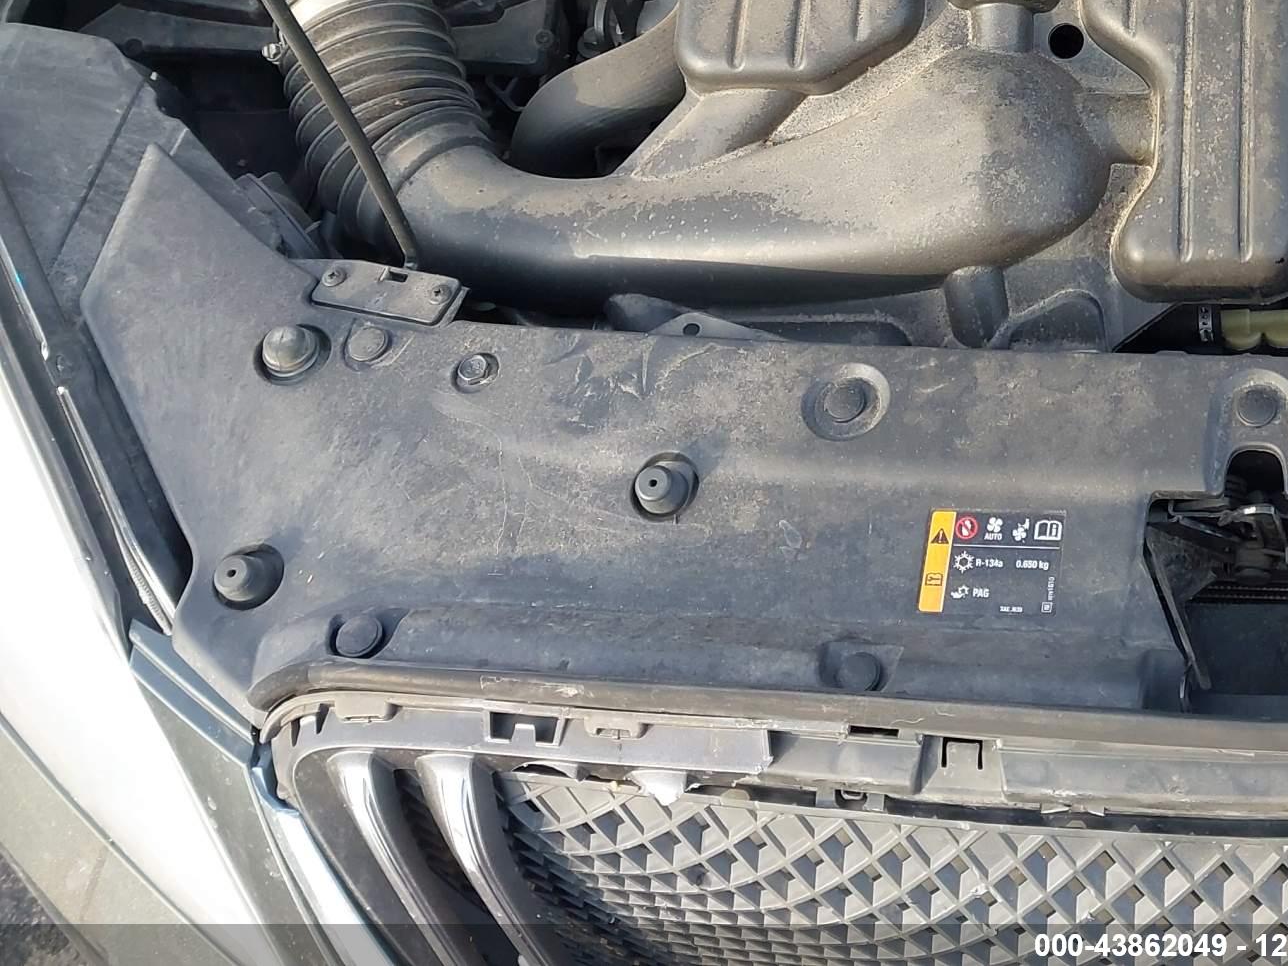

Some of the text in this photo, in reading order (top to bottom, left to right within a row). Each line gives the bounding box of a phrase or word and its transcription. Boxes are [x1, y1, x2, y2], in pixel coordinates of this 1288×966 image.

[984, 533, 1003, 541] AUTO
[975, 558, 1004, 568] R-134a
[1038, 560, 1049, 571] kg
[972, 588, 990, 598] PAG
